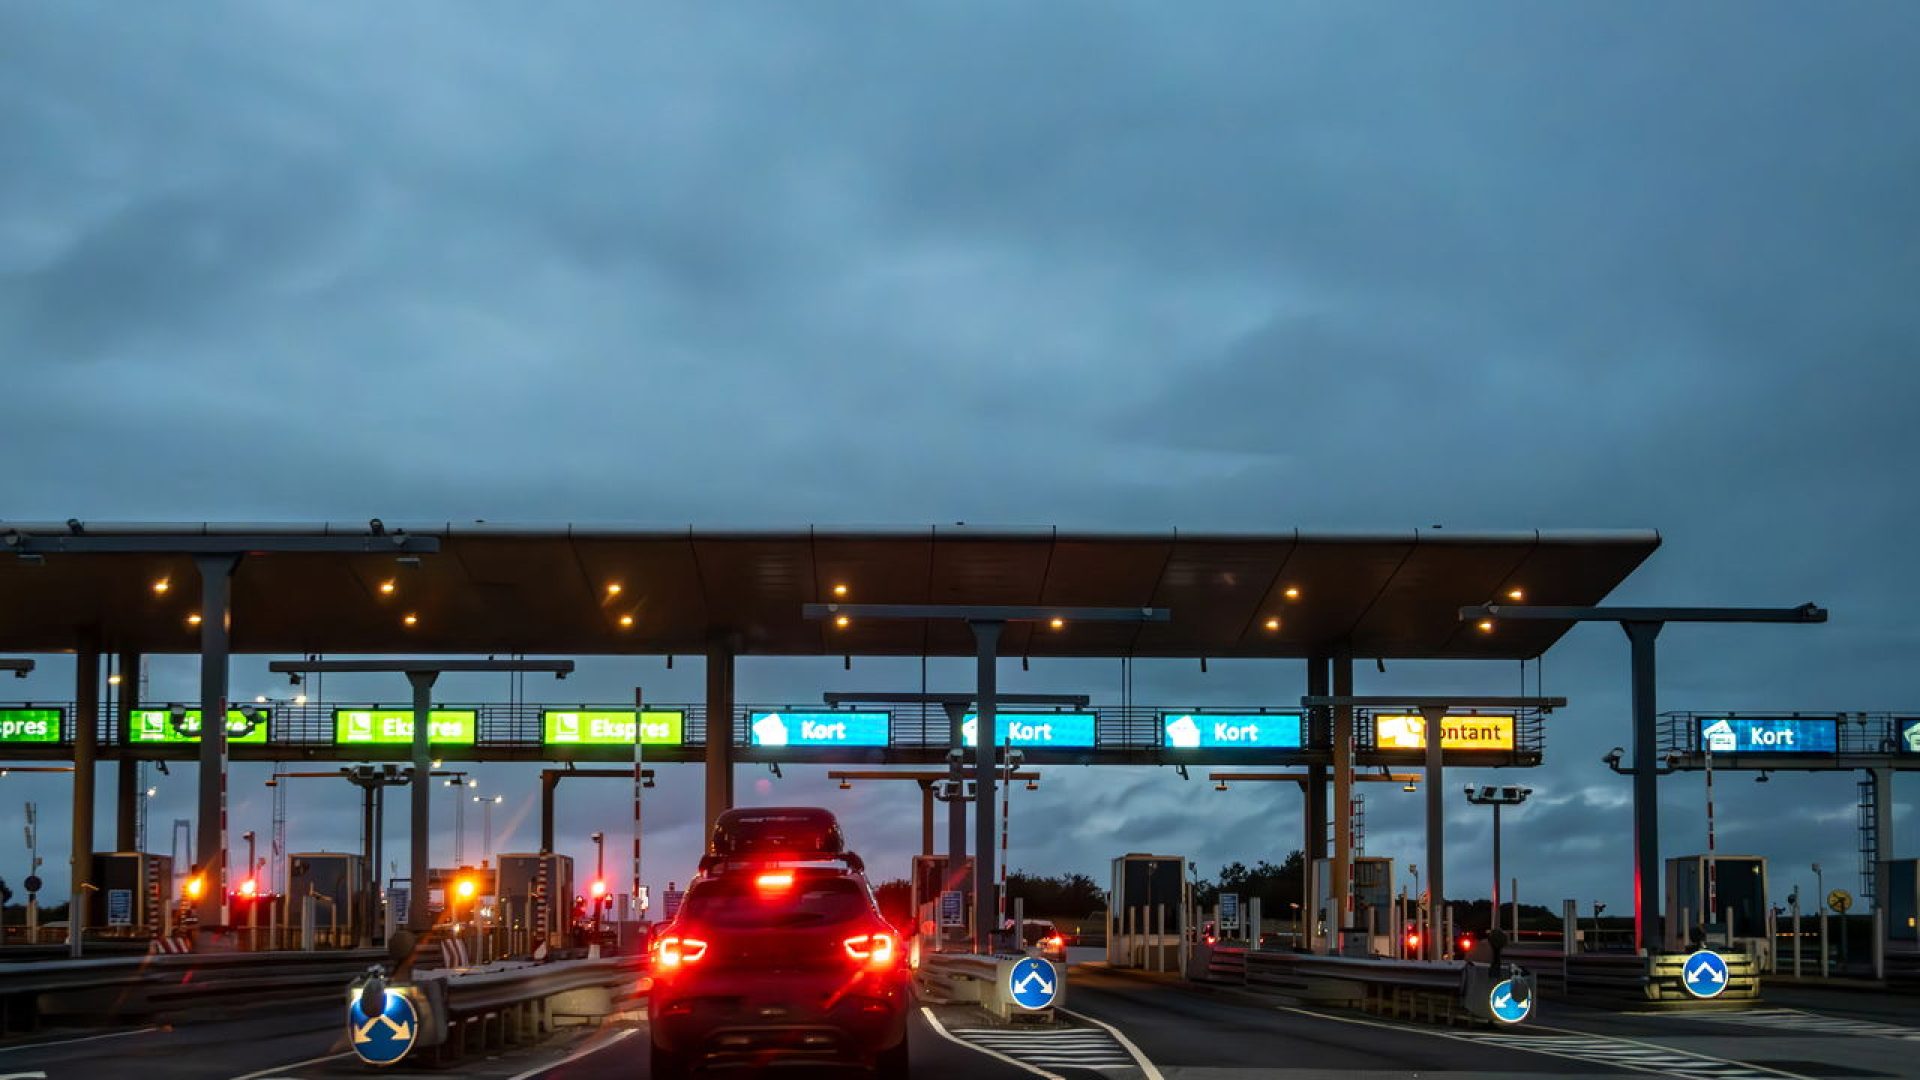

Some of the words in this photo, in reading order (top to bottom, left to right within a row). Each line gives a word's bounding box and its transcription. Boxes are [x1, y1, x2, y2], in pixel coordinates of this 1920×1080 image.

[0, 720, 47, 738] pres
[801, 720, 846, 740] Kort
[1008, 721, 1052, 740] Kort
[1214, 722, 1258, 741] Kort
[1434, 724, 1501, 740] ontant
[1751, 727, 1794, 745] Kort
